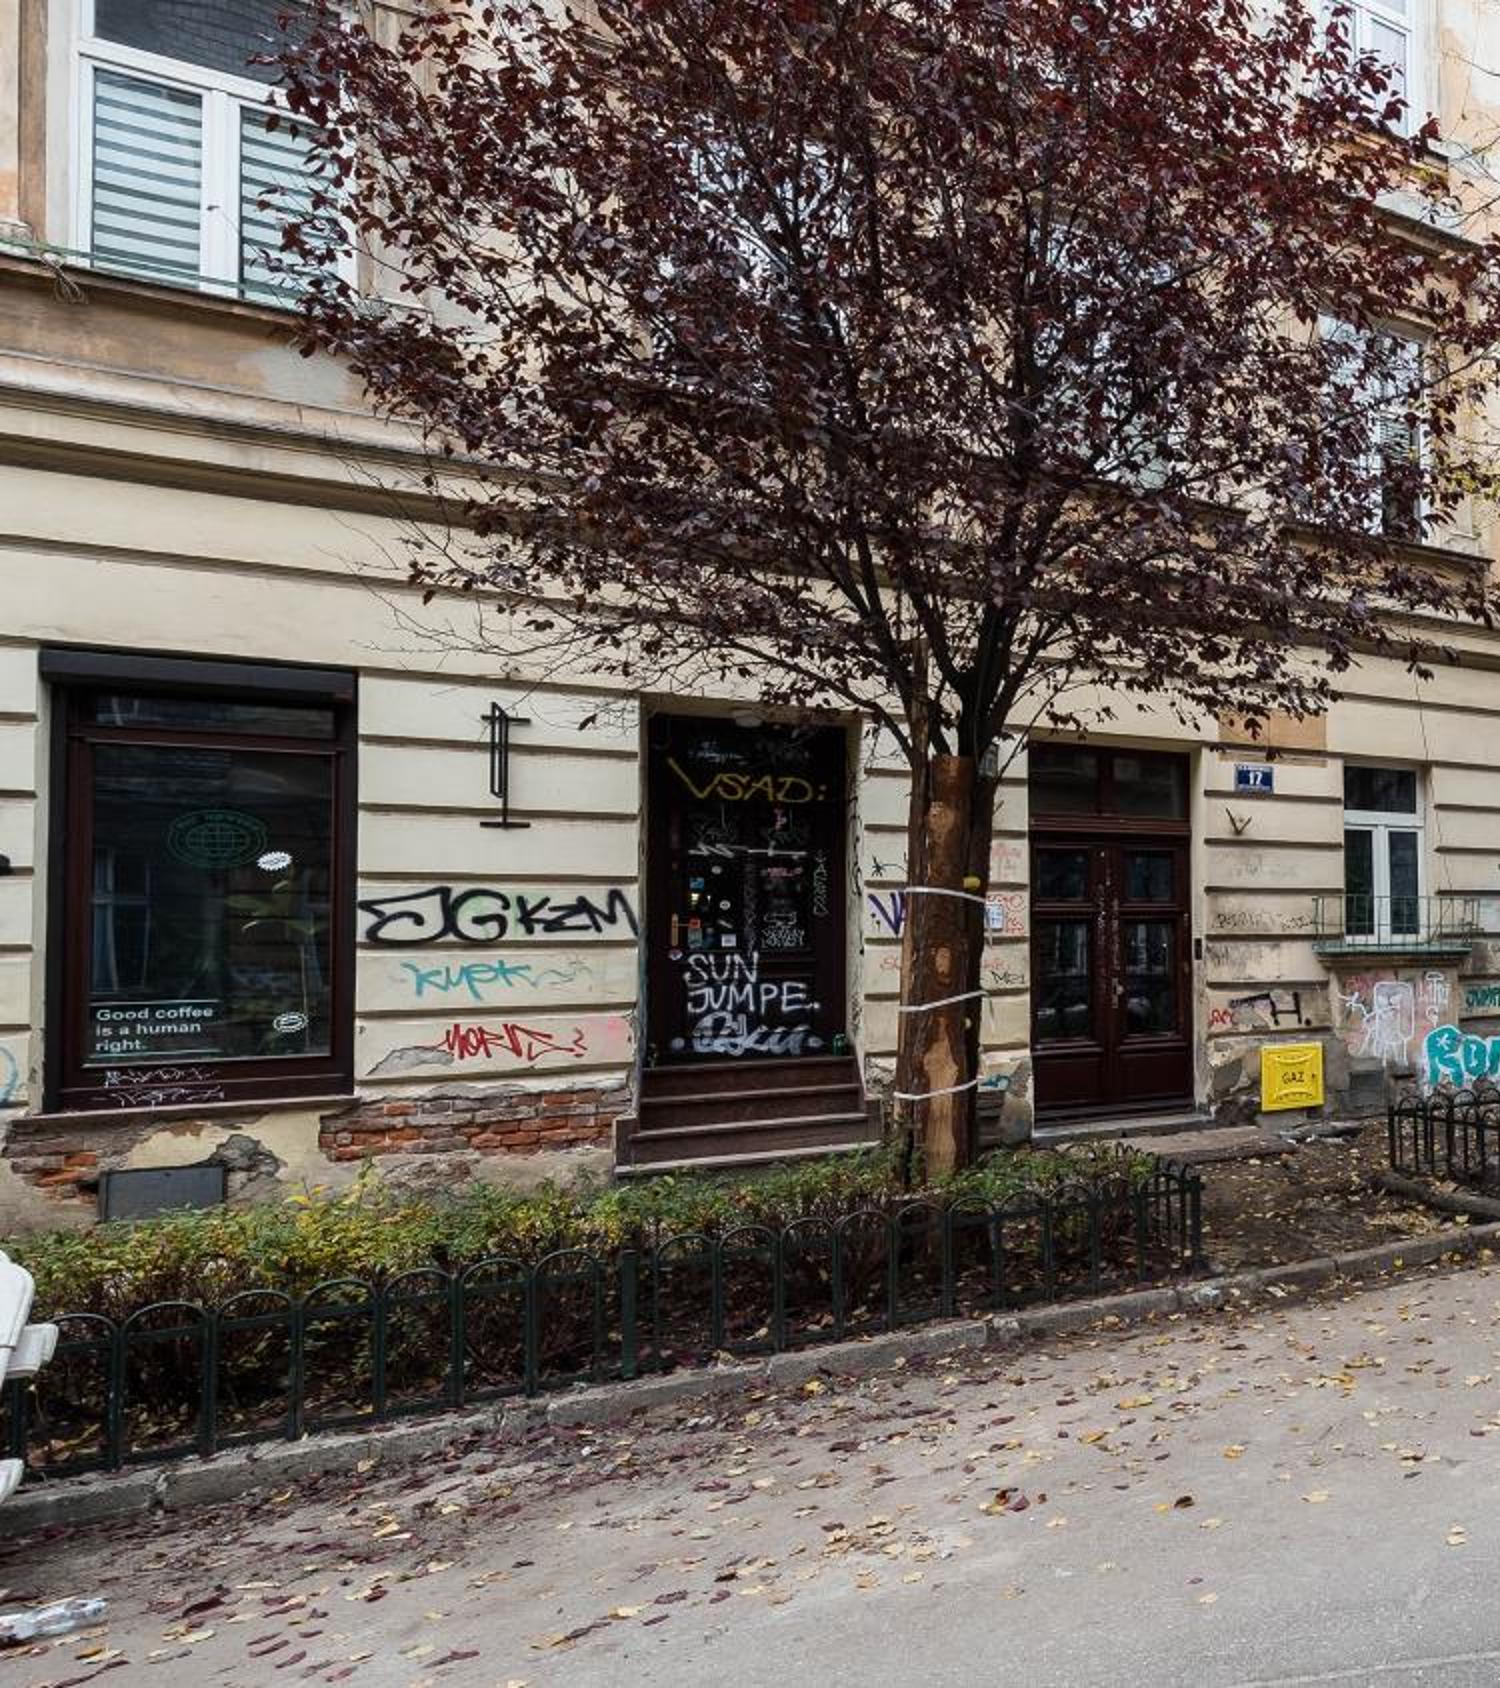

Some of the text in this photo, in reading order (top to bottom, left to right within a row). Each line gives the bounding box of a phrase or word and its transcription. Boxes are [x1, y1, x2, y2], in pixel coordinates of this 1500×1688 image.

[1249, 771, 1262, 785] 17
[683, 950, 759, 983] SUN
[96, 1005, 213, 1022] Good coffee
[96, 1022, 201, 1036] is a human
[96, 1038, 147, 1052] right.
[1282, 1071, 1305, 1084] GAZ
